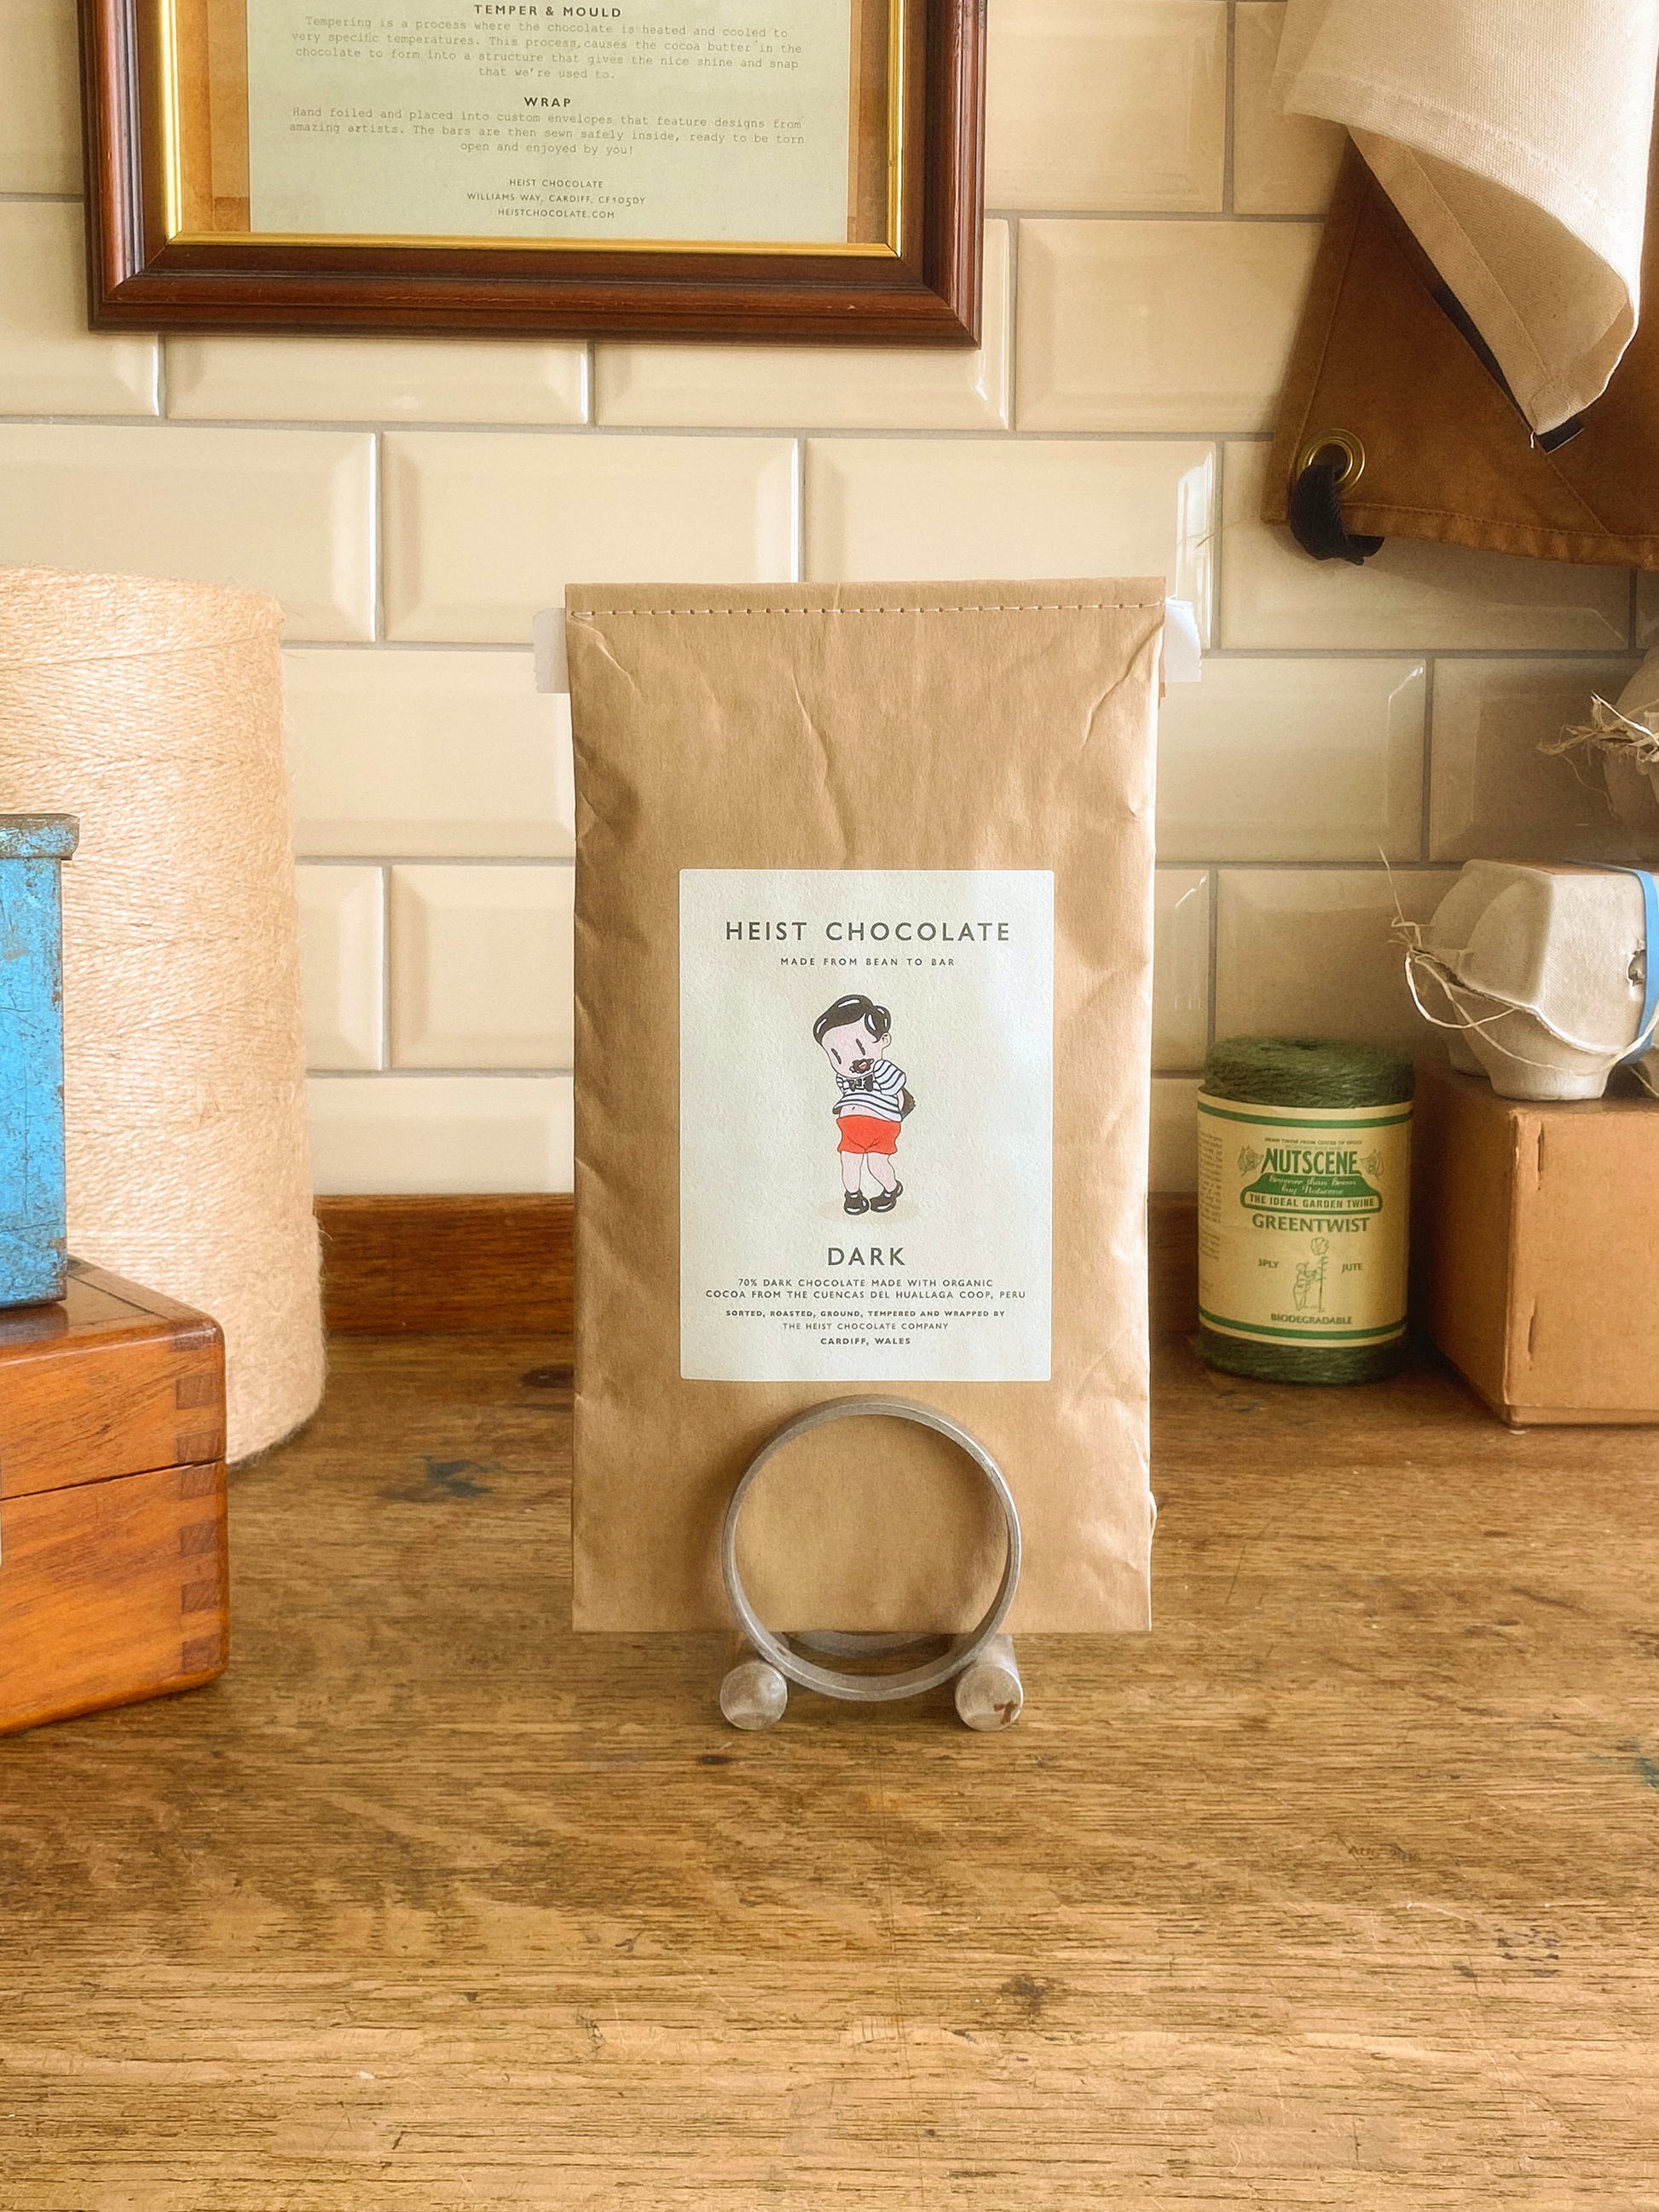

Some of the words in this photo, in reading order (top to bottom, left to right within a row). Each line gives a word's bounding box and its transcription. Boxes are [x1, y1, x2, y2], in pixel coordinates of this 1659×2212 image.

[474, 5, 537, 15] TEMPER
[546, 7, 554, 15] &
[564, 7, 621, 17] MOULD
[306, 16, 372, 28] Tempering
[380, 17, 393, 27] is
[402, 19, 408, 28] a
[416, 20, 466, 31] process
[475, 20, 510, 31] where
[519, 21, 540, 32] the
[547, 22, 612, 33] chocolate
[622, 24, 633, 33] is
[643, 25, 685, 35] heated
[694, 26, 714, 36] and
[723, 26, 766, 38] cooled
[774, 28, 788, 38] to
[292, 32, 321, 43] very
[329, 32, 379, 43] specific
[387, 34, 480, 45] temperatures.
[489, 37, 517, 46] This
[585, 41, 627, 49] causes
[636, 40, 656, 49] the
[665, 43, 700, 51] cocoa
[708, 41, 750, 52] butter
[760, 43, 772, 53] in
[782, 43, 801, 54] the
[296, 48, 361, 57] chocolate
[369, 49, 383, 58] to
[391, 49, 419, 59] form
[428, 50, 456, 60] into
[479, 53, 543, 62] structure
[552, 53, 578, 63] that
[587, 55, 623, 66] gives
[632, 55, 652, 65] the
[661, 56, 689, 66] nice
[697, 57, 732, 67] shine
[741, 59, 761, 68] and
[770, 61, 798, 70] snap
[479, 66, 506, 77] that
[515, 67, 550, 78] we're
[558, 69, 587, 78] used
[596, 70, 614, 78] to.
[524, 97, 570, 107] WRAP
[293, 107, 321, 117] Hand
[330, 108, 373, 118] foiled
[380, 110, 402, 119] and
[409, 110, 453, 121] placed
[462, 111, 489, 121] into
[497, 113, 540, 122] custom
[547, 114, 612, 125] envelopes
[621, 115, 647, 124] that
[657, 116, 707, 126] feature
[714, 118, 765, 130] designs
[773, 118, 801, 129] from
[290, 123, 339, 135] amazing
[348, 124, 404, 134] artists.
[413, 125, 434, 135] The
[442, 126, 471, 135] bars
[508, 128, 536, 136] then
[545, 130, 572, 138] sewn
[581, 129, 623, 141] safely
[632, 130, 680, 141] inside,
[690, 132, 725, 143] ready
[733, 134, 746, 142] to
[754, 134, 768, 143] be
[777, 135, 804, 144] torn
[460, 143, 489, 153] open
[497, 142, 518, 152] and
[526, 143, 576, 154] enjoyed
[584, 144, 598, 155] by
[606, 146, 633, 155] you!
[542, 180, 603, 188] CHOCOLATE
[467, 193, 515, 201] WILLIAMS
[520, 194, 543, 203] WAY,
[549, 195, 592, 204] CARDIFF,
[498, 209, 615, 218] HEISTCHOCOLATE.COM
[725, 921, 807, 941] HEIST
[826, 921, 1010, 942] CHOCOLATE
[780, 957, 816, 966] MADE
[823, 957, 858, 966] FROM
[866, 957, 899, 966] BEAN
[907, 957, 924, 966] TO
[931, 957, 955, 966] BAR
[1261, 1147, 1362, 1175] NUTSCENE
[1250, 1194, 1266, 1204] THE
[1270, 1197, 1298, 1207] IDEAL
[1303, 1198, 1343, 1209] GARDEN
[1347, 1198, 1375, 1208] TWINE
[1252, 1213, 1370, 1233] GREENTWIST
[827, 1247, 905, 1266] DARK
[1341, 1262, 1363, 1273] JUTE
[738, 1279, 757, 1287] 70%
[706, 1291, 746, 1299] COCOA
[752, 1291, 781, 1299] FROM
[787, 1291, 808, 1299] THE
[813, 1291, 864, 1299] CUENCAS
[870, 1291, 890, 1299] DEL
[896, 1291, 953, 1299] HUALLAGA
[959, 1291, 993, 1301] COOP,
[999, 1291, 1026, 1299] PERU
[1271, 1314, 1352, 1324] BIODEGRADABLE
[820, 1337, 869, 1346] CARDIFF,
